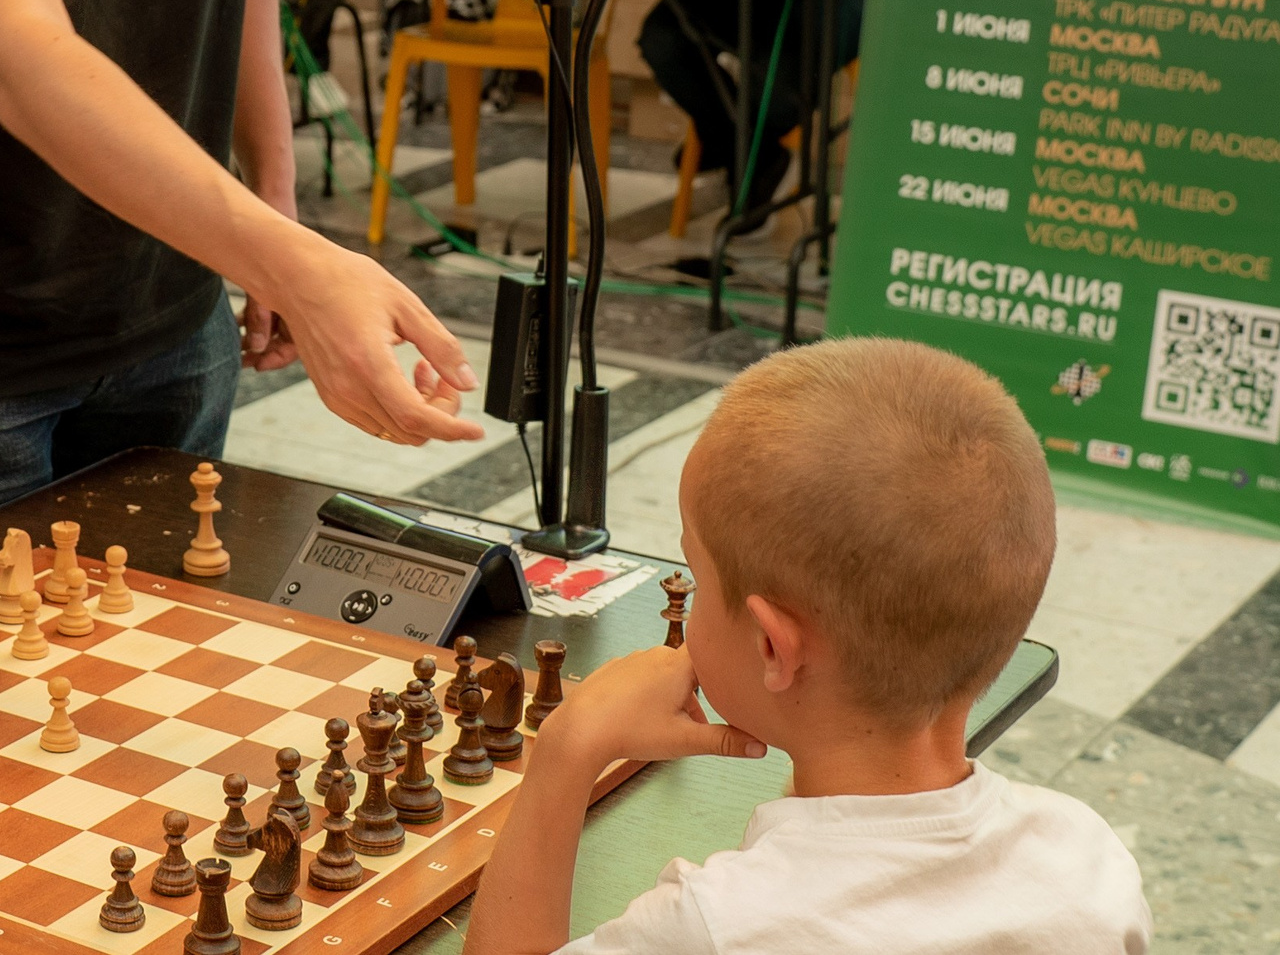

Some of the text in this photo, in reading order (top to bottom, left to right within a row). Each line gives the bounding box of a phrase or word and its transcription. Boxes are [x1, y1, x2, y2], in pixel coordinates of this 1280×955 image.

[936, 9, 1031, 44] 1 ИЮНЯ
[1049, 23, 1161, 59] МОСКВА
[925, 64, 1024, 100] 8 ИЮНЯ
[1048, 51, 1091, 80] ТРЦ
[1042, 80, 1119, 112] СОЧИ
[911, 118, 1017, 156] 15 ИЮНЯ
[1038, 108, 1102, 137] PARK
[1105, 116, 1152, 145] INN
[1154, 122, 1188, 150] BY
[1035, 136, 1146, 174] МОСКВА
[898, 173, 1010, 212] 22 ИЮНЯ
[1032, 164, 1238, 216] VEGAS КУНЦЕВО
[1028, 192, 1138, 231] МОСКВА
[1025, 220, 1272, 282] VEGAS КАШИРСКОЕ
[890, 247, 1123, 312] РЕГИСТРАЦИЯ
[886, 281, 1117, 341] CHESSSTARS.RU
[322, 828, 496, 946] G F E D
